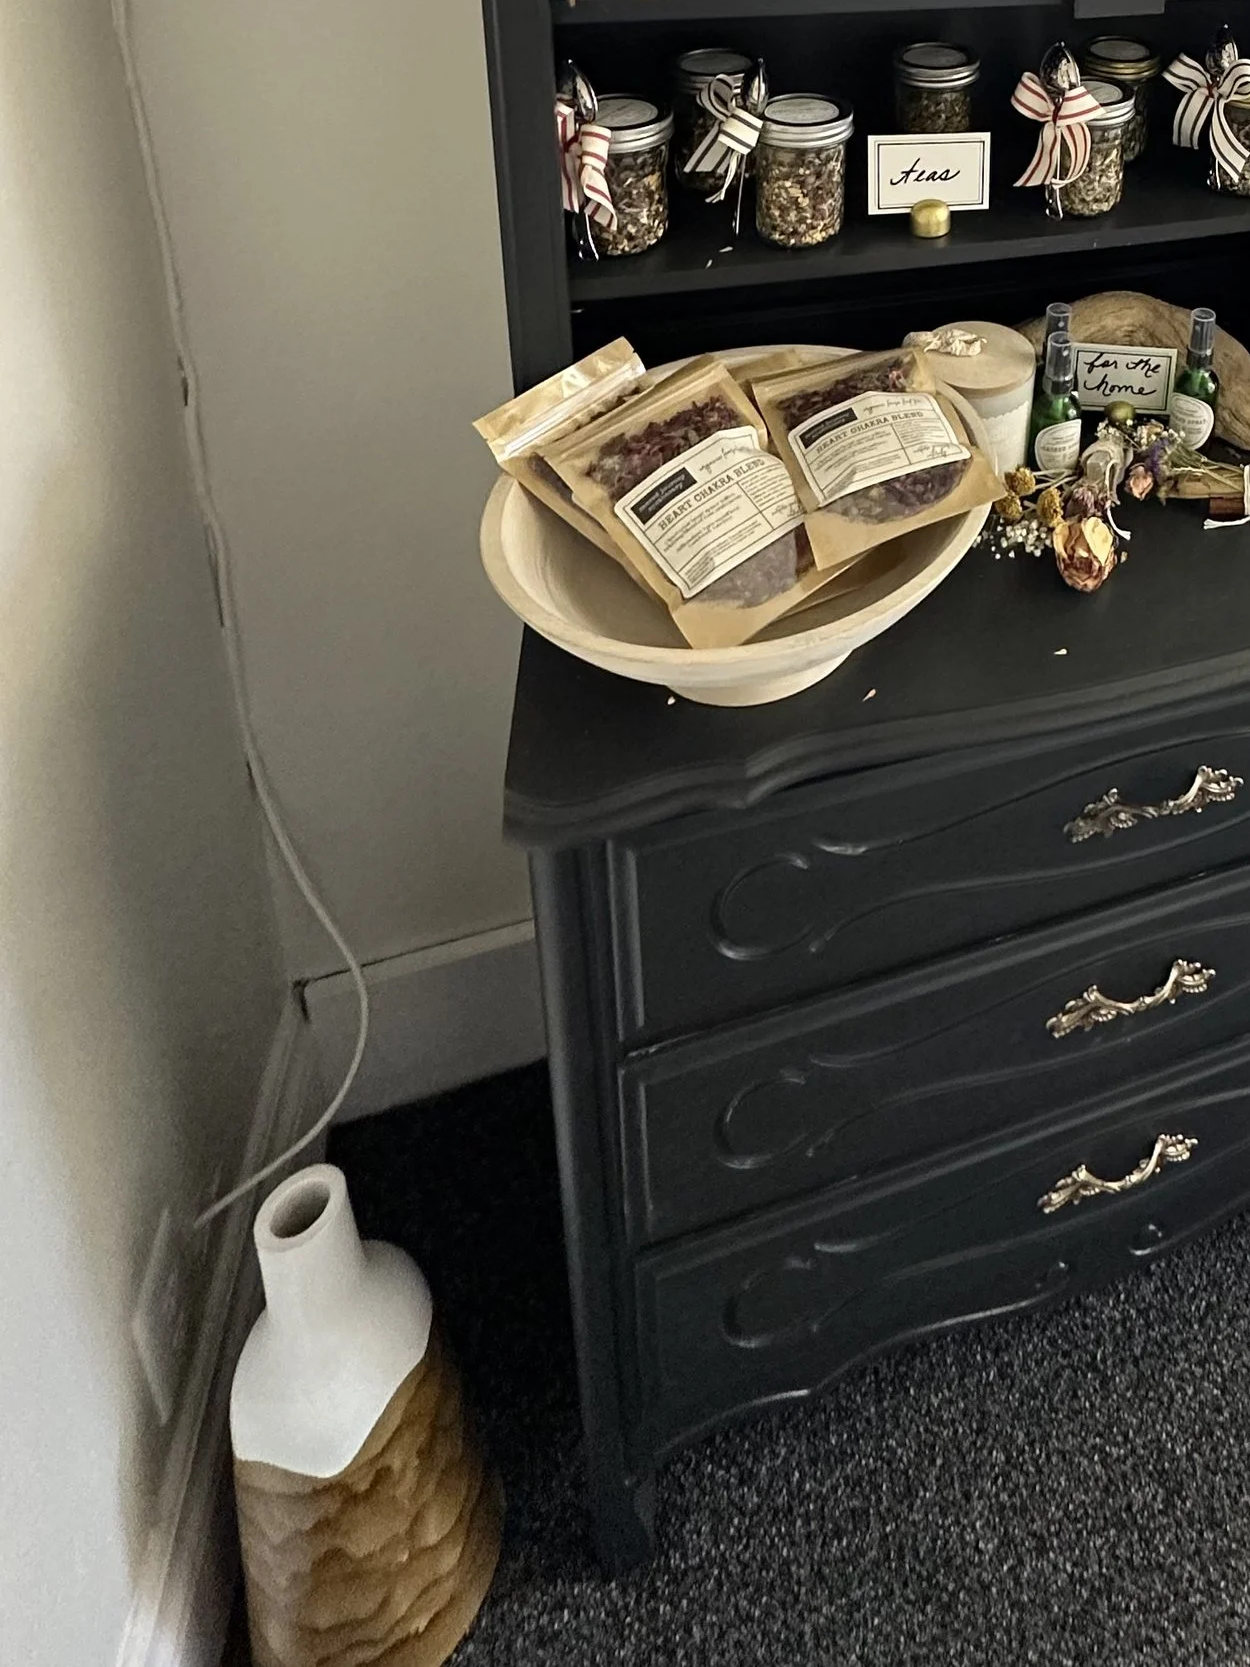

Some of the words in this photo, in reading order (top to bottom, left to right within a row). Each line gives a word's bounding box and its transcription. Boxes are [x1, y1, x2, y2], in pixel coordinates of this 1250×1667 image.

[890, 157, 961, 185] teas
[1083, 352, 1119, 371] for
[1126, 357, 1162, 379] the
[1083, 372, 1158, 397] home
[850, 417, 890, 434] CHAKRA
[891, 411, 924, 425] BLEND
[657, 499, 693, 532] HEART
[693, 473, 735, 503] CHAKRA
[734, 457, 767, 481] BLEND
